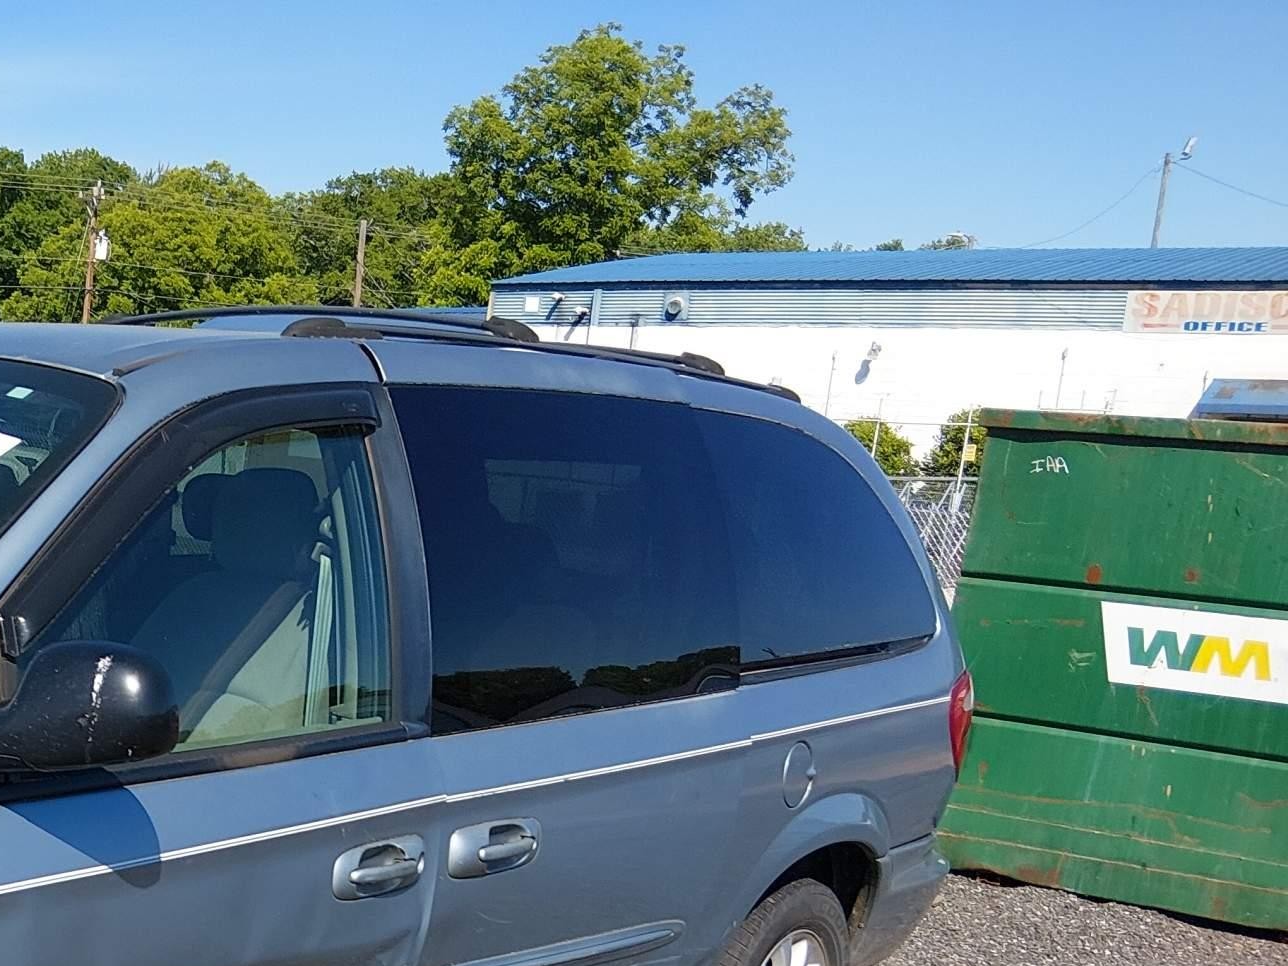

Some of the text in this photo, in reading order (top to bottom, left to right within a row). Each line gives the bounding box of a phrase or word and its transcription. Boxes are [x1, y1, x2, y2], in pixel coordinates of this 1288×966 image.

[1183, 321, 1269, 332] OFFICE
[1029, 456, 1070, 474] IAA
[1128, 626, 1272, 682] WM
